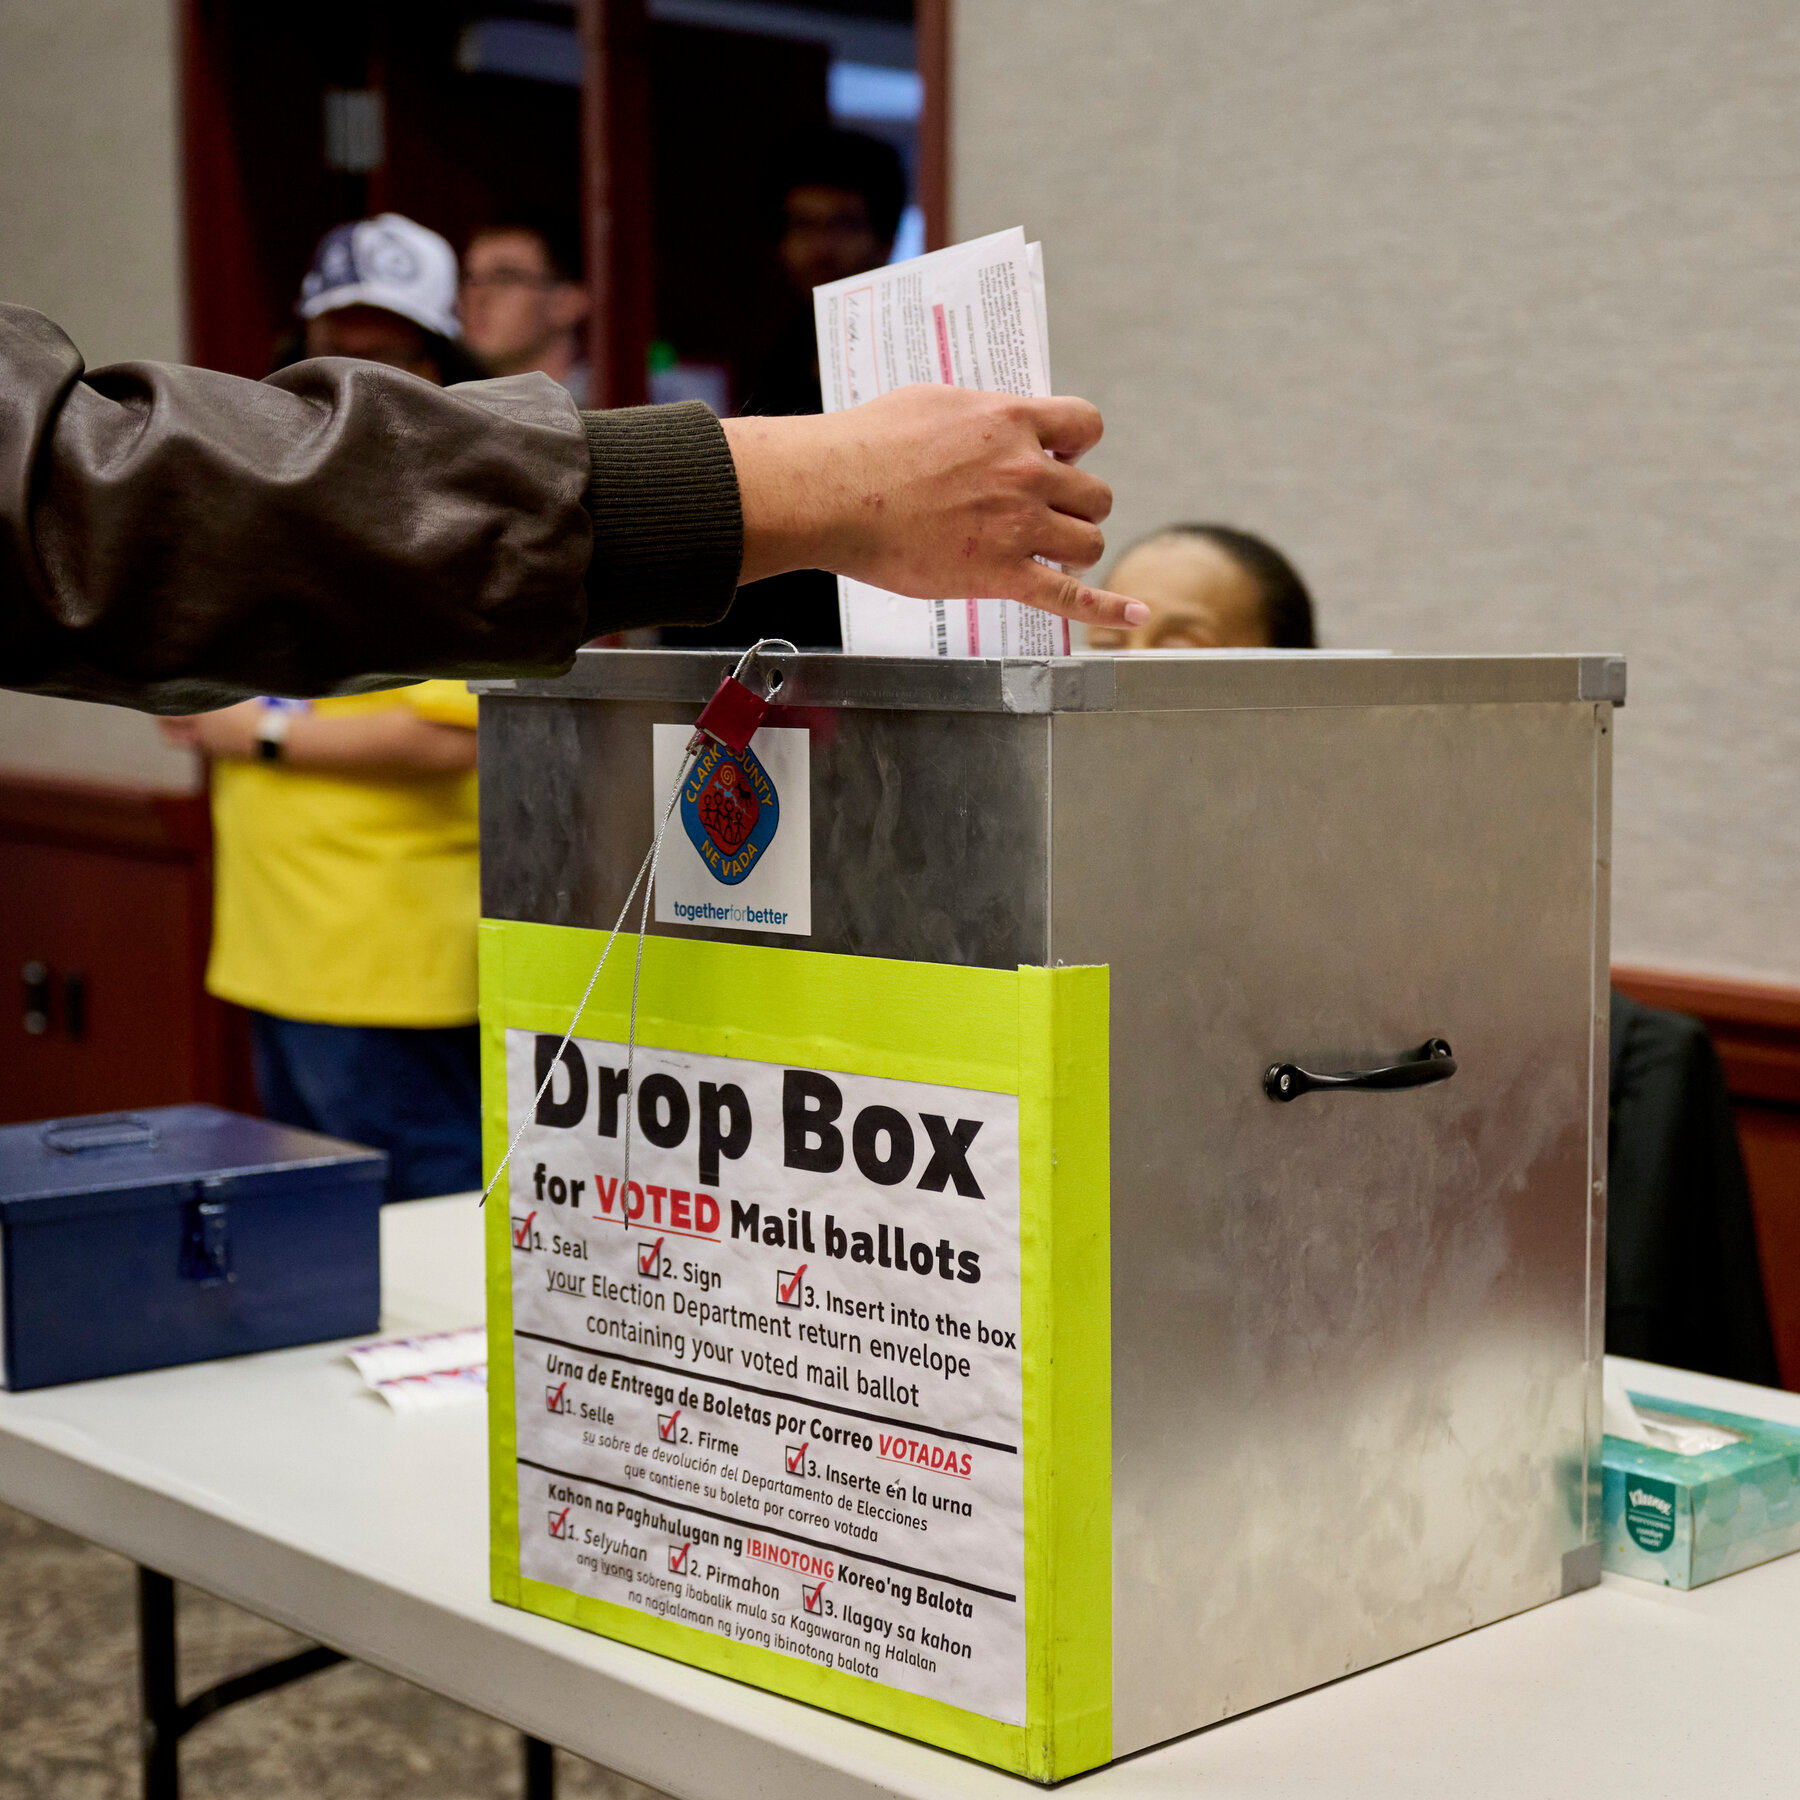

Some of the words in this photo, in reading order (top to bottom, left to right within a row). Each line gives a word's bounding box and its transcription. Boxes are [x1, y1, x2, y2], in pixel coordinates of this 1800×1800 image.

[1011, 289, 1022, 325] direction
[686, 744, 722, 803] CLARK
[674, 901, 788, 925] togetherforbetter
[701, 839, 759, 877] NEVADA
[534, 1033, 753, 1188] Drop
[782, 1069, 986, 1201] Box
[533, 1162, 586, 1209] for
[594, 1174, 721, 1234] VOTED
[730, 1199, 816, 1254] Mail
[824, 1214, 981, 1284] ballots
[533, 1231, 548, 1253] 1.
[552, 1234, 588, 1261] Seal
[662, 1257, 678, 1280] 2.
[683, 1261, 722, 1292] Sign
[804, 1285, 820, 1310] 3.
[826, 1290, 885, 1323] Insert
[890, 1302, 930, 1332] into
[935, 1313, 971, 1341] the
[977, 1319, 1017, 1350] box
[546, 1268, 586, 1298] your
[592, 1274, 665, 1312] Election
[673, 1291, 792, 1339] Department
[798, 1323, 862, 1354] return
[869, 1338, 971, 1381] envelope
[546, 1353, 584, 1381] Urna
[587, 1363, 608, 1386] de
[610, 1369, 675, 1407] Entrega
[678, 1386, 699, 1410] de
[703, 1392, 772, 1427] Boletas
[775, 1413, 807, 1436] por
[809, 1418, 873, 1452] Correo
[879, 1433, 973, 1476] VOTADAS
[586, 1315, 685, 1360] containing
[691, 1338, 734, 1365] your
[740, 1349, 798, 1380] voted
[806, 1364, 850, 1392] mail
[857, 1369, 919, 1408] ballot
[565, 1398, 576, 1416] 1.
[579, 1402, 615, 1426] Selle
[679, 1427, 693, 1445] 2.
[698, 1430, 739, 1457] Firme
[807, 1459, 821, 1479] 3.
[826, 1464, 881, 1495] Inserte
[886, 1483, 907, 1502] en
[912, 1485, 927, 1507] la
[932, 1495, 973, 1518] urna
[582, 1430, 596, 1444] su
[598, 1435, 631, 1453] sobre
[633, 1442, 649, 1458] de
[652, 1446, 717, 1475] devolución
[720, 1464, 739, 1482] del
[741, 1469, 834, 1506] Departamento
[837, 1494, 853, 1512] de
[856, 1499, 928, 1532] Elecciones
[624, 1464, 646, 1480] que
[649, 1471, 701, 1494] contiene
[703, 1485, 717, 1499] su
[720, 1486, 760, 1510] boleta
[763, 1501, 785, 1517] por
[788, 1508, 830, 1529] correo
[834, 1519, 878, 1543] votada
[548, 1483, 593, 1510] Kahon
[595, 1499, 614, 1515] na
[616, 1501, 720, 1547] Paghuhulugan
[723, 1535, 743, 1558] ng
[746, 1537, 834, 1579] IBINOTONG
[837, 1564, 912, 1607] Koreo'ng
[916, 1585, 973, 1619] Balota
[567, 1524, 579, 1542] 1.
[583, 1528, 648, 1562] Selyuhan
[689, 1559, 702, 1578] 2.
[706, 1564, 780, 1601] Pirmahon
[824, 1599, 838, 1619] 3.
[842, 1604, 893, 1639] Ilagay
[896, 1624, 916, 1642] sa
[920, 1626, 972, 1659] kahon
[576, 1553, 599, 1573] ang
[600, 1558, 634, 1583] iyong
[636, 1571, 683, 1599] sobreng
[685, 1584, 732, 1611] ibabalik
[736, 1602, 768, 1621] mula
[770, 1612, 786, 1627] sa
[790, 1614, 861, 1650] Kagawaran
[864, 1641, 881, 1660] ng
[885, 1643, 936, 1673] Halalan
[628, 1590, 643, 1604] na
[645, 1596, 714, 1627] naglalaman
[717, 1619, 732, 1637] ng
[735, 1625, 771, 1649] iyong
[774, 1633, 834, 1669] ibinotong
[837, 1652, 879, 1679] balota
